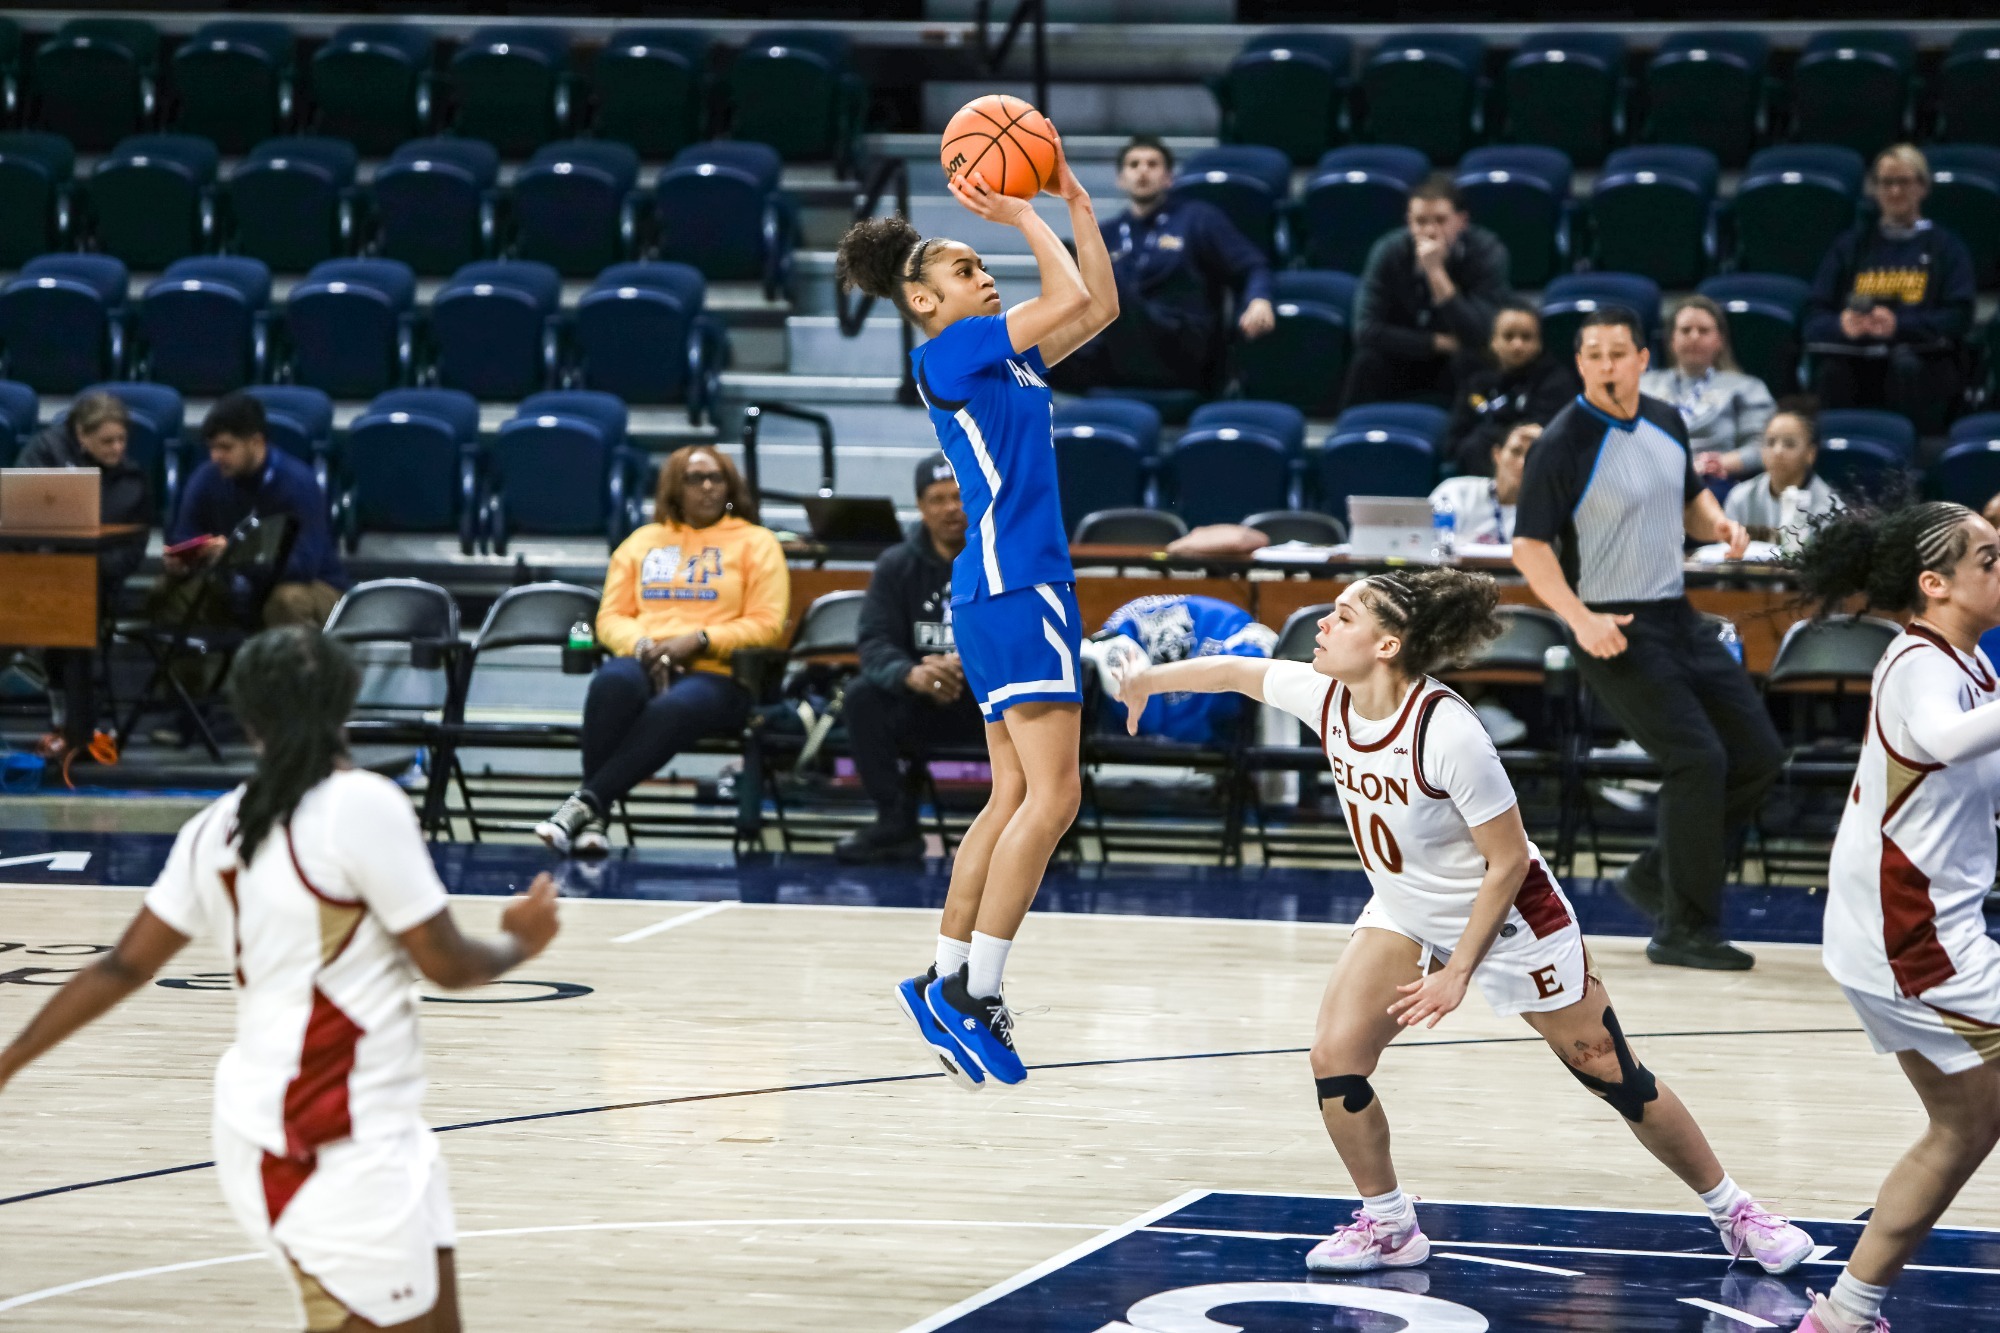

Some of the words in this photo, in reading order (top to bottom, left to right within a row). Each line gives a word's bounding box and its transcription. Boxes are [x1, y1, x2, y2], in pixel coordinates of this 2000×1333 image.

[1332, 753, 1409, 806] ELON
[1346, 798, 1404, 874] 10
[1528, 963, 1564, 1000] E
